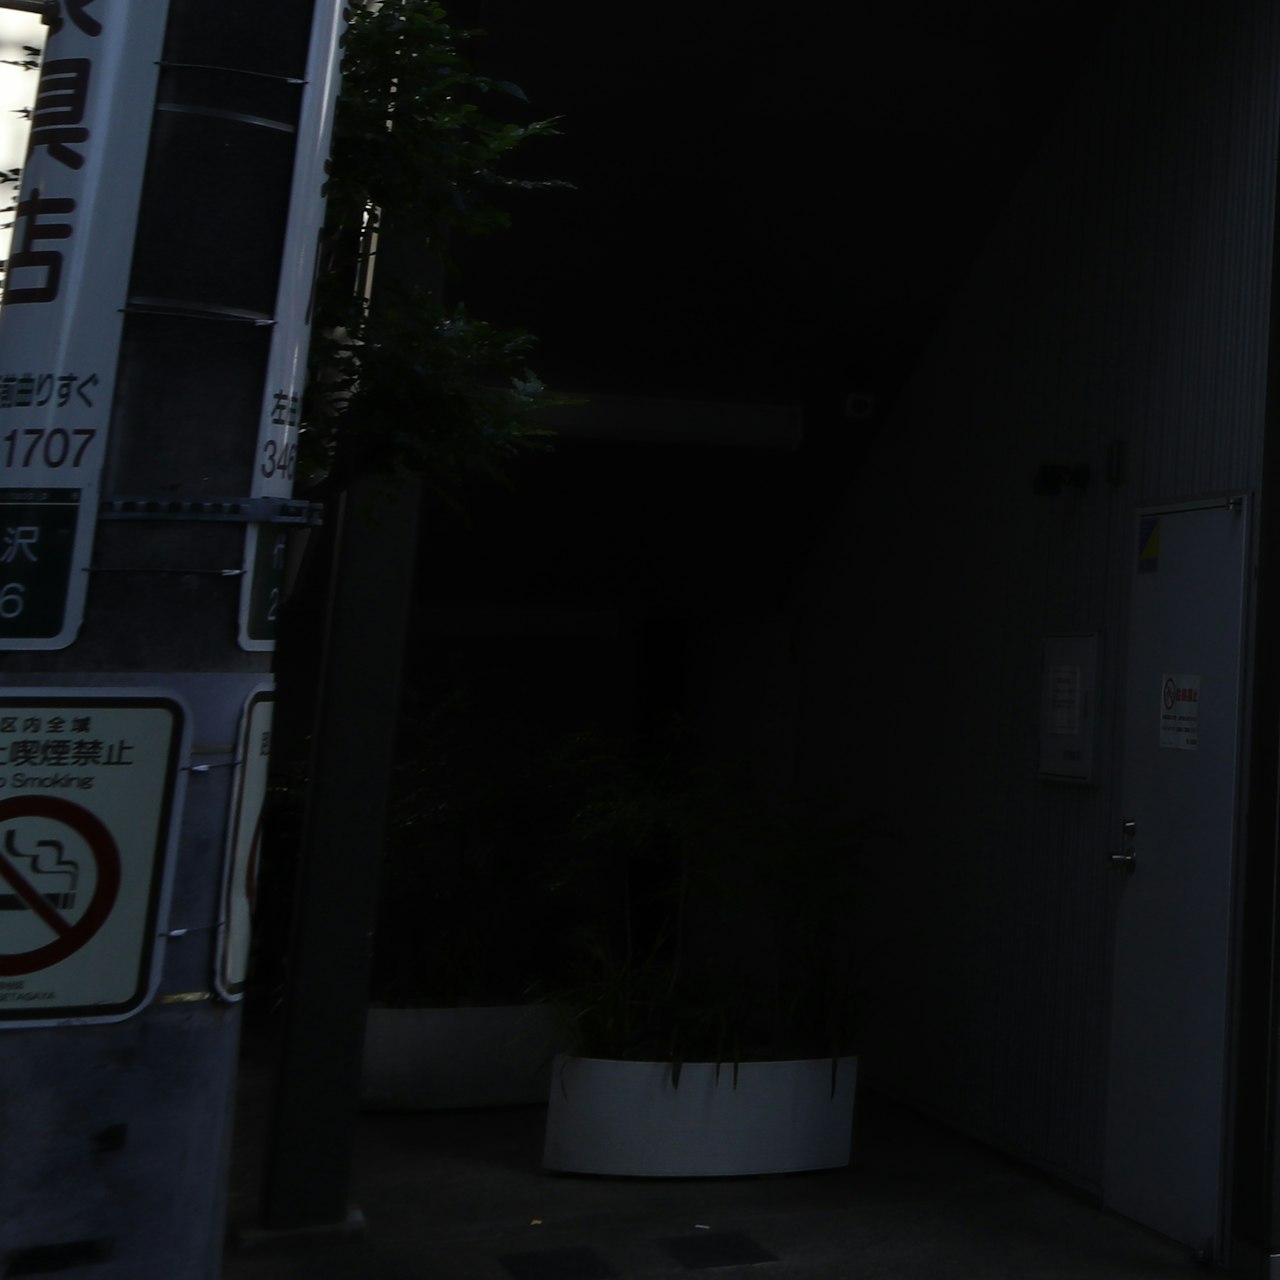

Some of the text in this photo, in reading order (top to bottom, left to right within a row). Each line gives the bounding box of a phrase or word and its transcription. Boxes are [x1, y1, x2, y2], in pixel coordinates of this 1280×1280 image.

[4, 428, 97, 468] 1707
[0, 526, 40, 563] 沢
[0, 739, 135, 767] 喫煙禁止
[12, 772, 95, 790] Smoking
